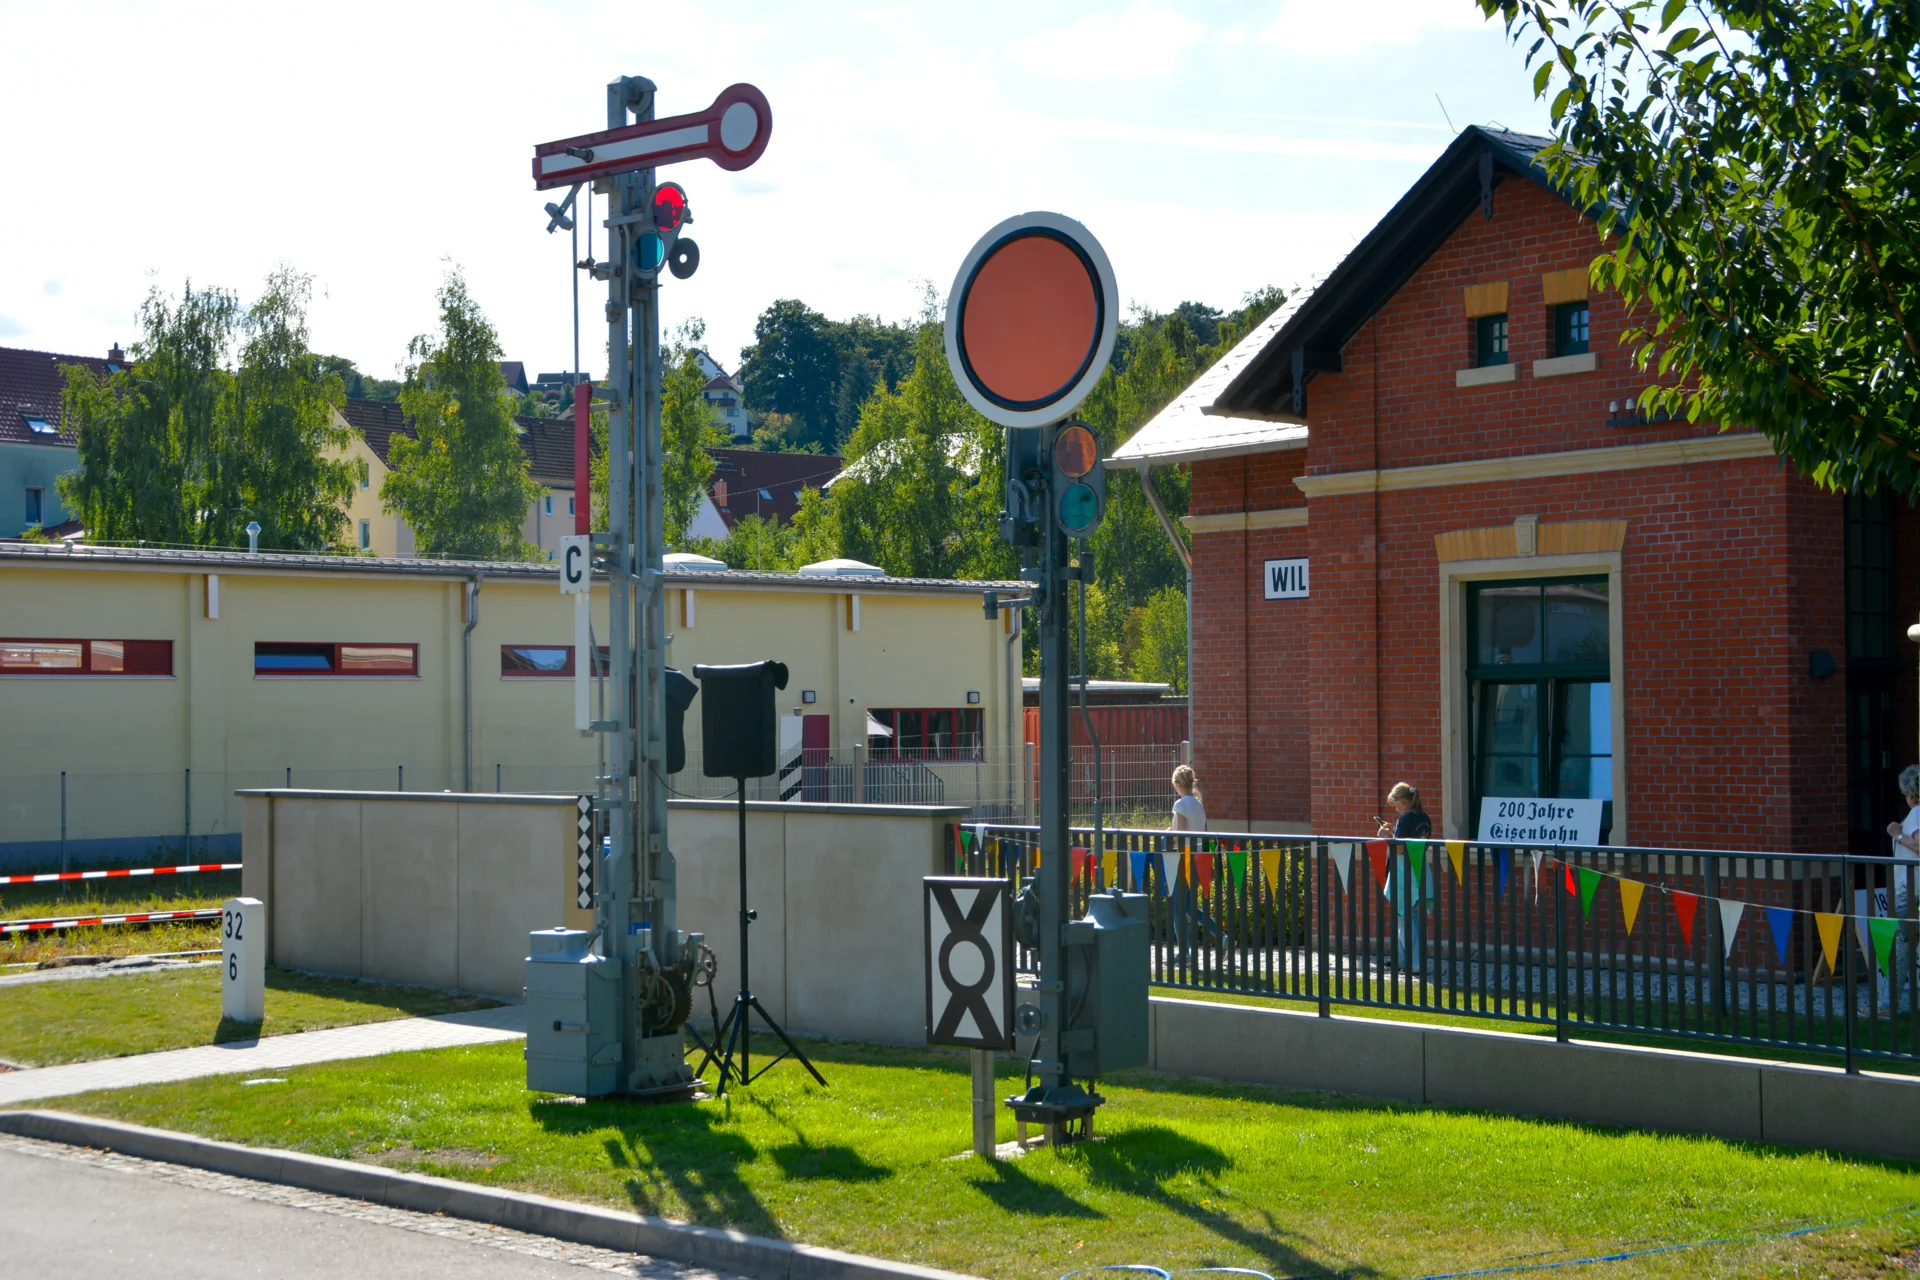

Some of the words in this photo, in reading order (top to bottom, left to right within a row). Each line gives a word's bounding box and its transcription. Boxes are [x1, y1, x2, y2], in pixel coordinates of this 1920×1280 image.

[565, 545, 582, 584] C
[1271, 565, 1306, 592] WIL
[1498, 801, 1525, 818] 200
[225, 910, 243, 940] 32
[229, 952, 238, 981] 6
